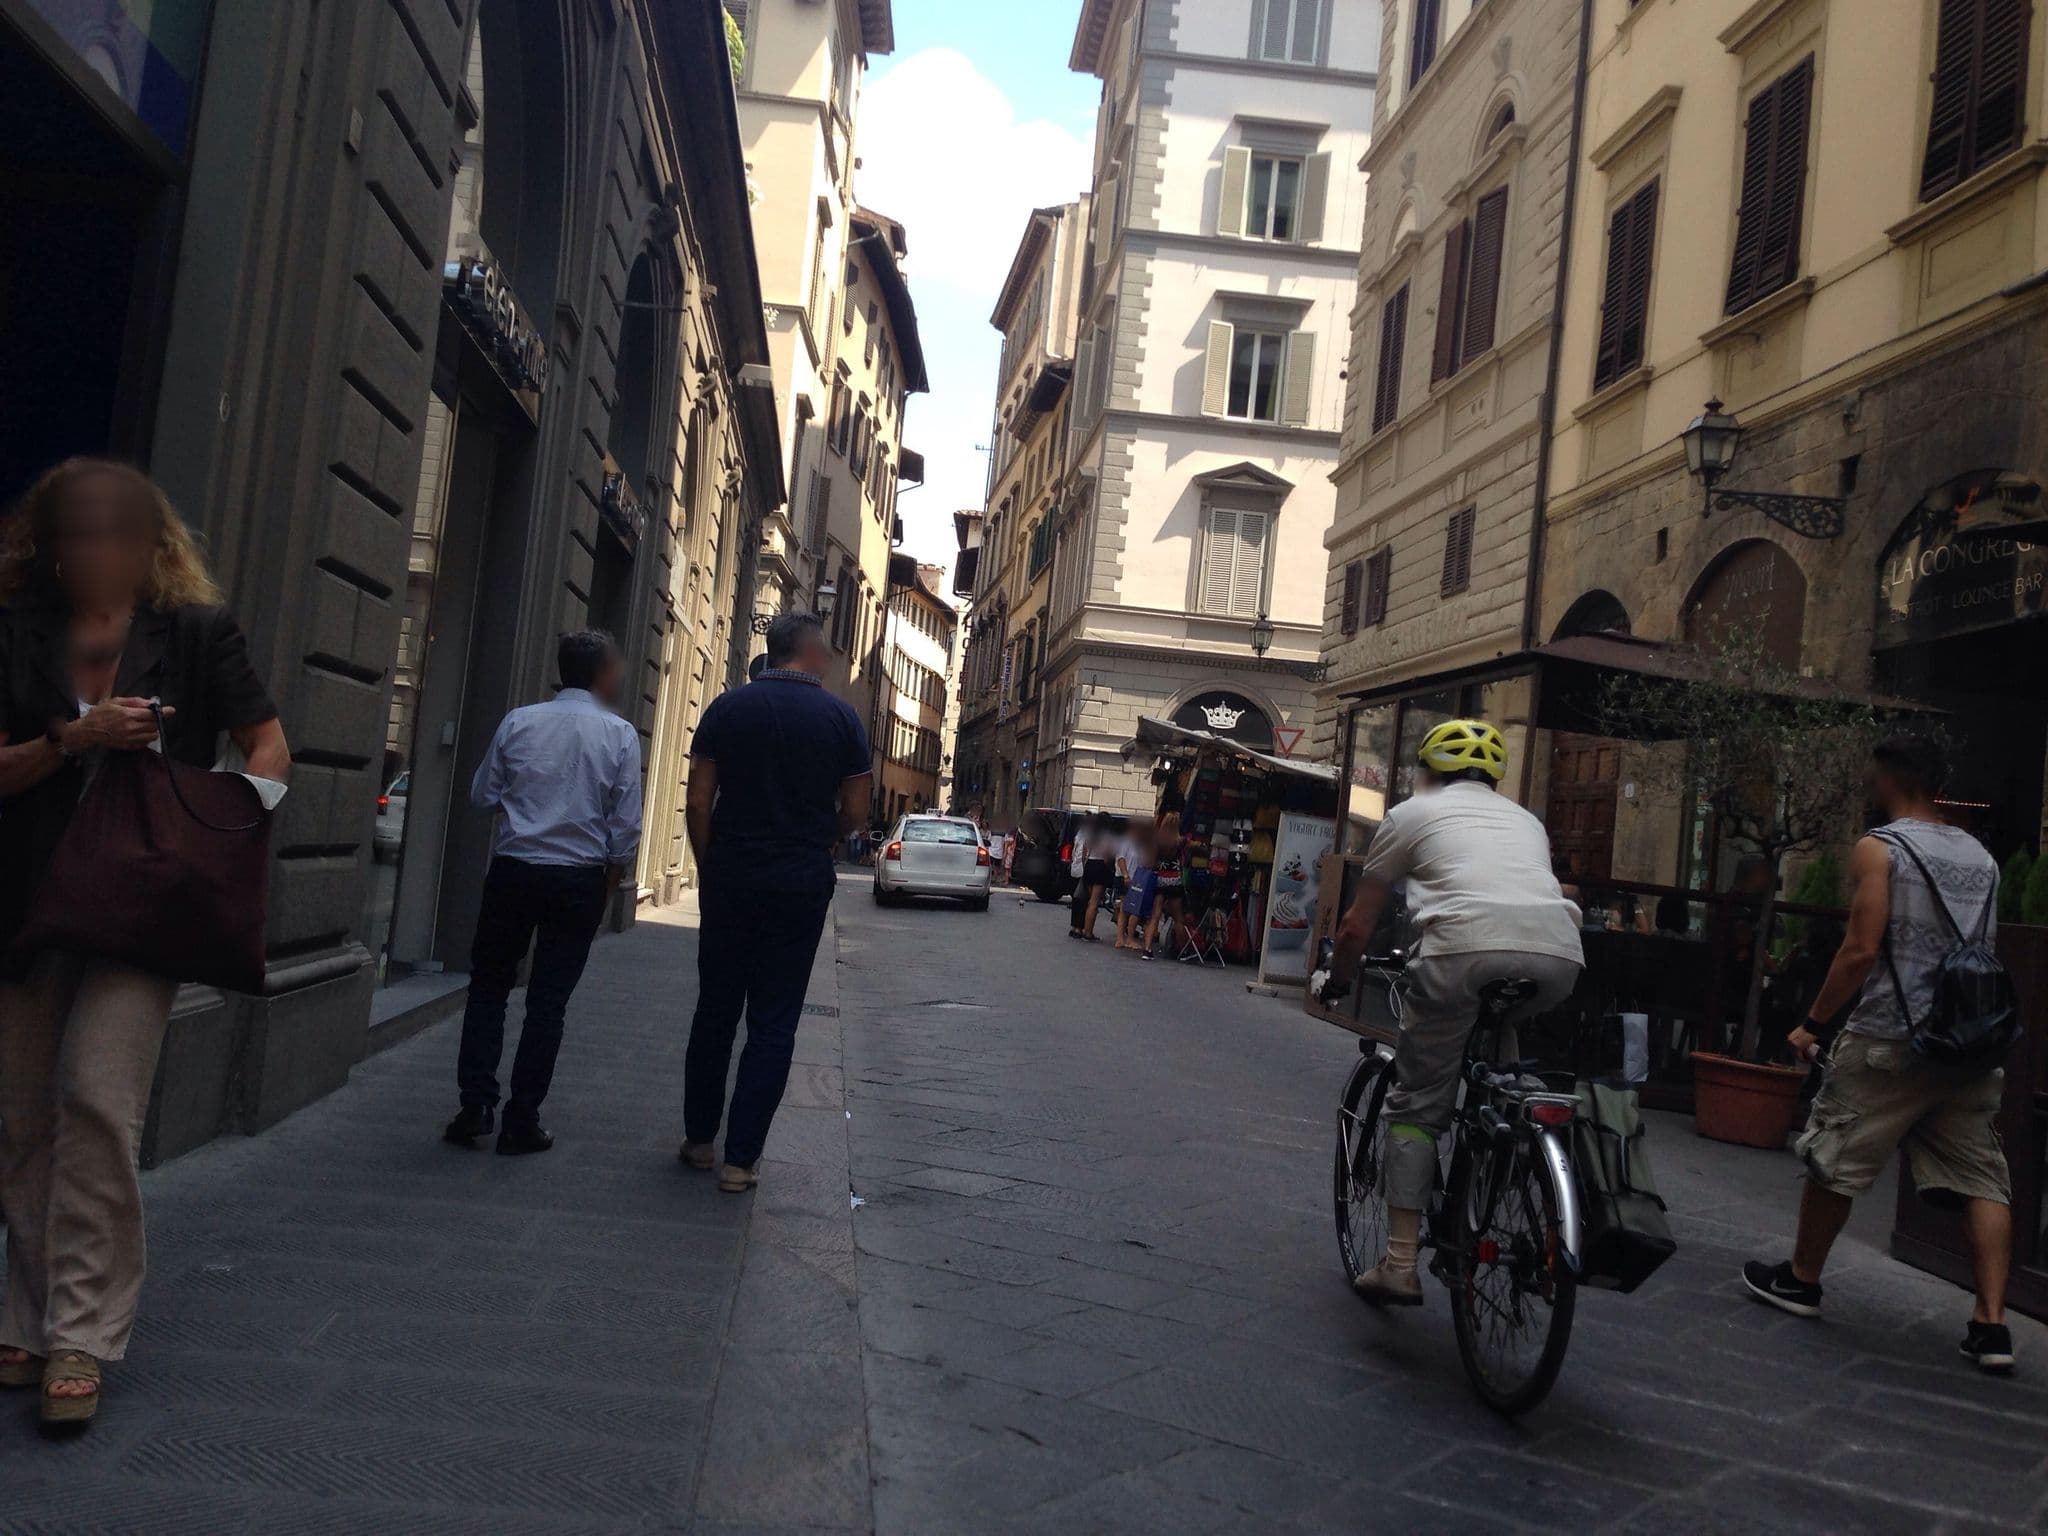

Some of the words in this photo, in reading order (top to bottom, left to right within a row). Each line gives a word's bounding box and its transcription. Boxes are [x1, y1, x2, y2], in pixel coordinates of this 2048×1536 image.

[1891, 556, 1915, 585] LA
[1952, 584, 2011, 609] LOUNGE
[2014, 572, 2043, 596] BAR
[1288, 820, 1318, 836] YOGURT
